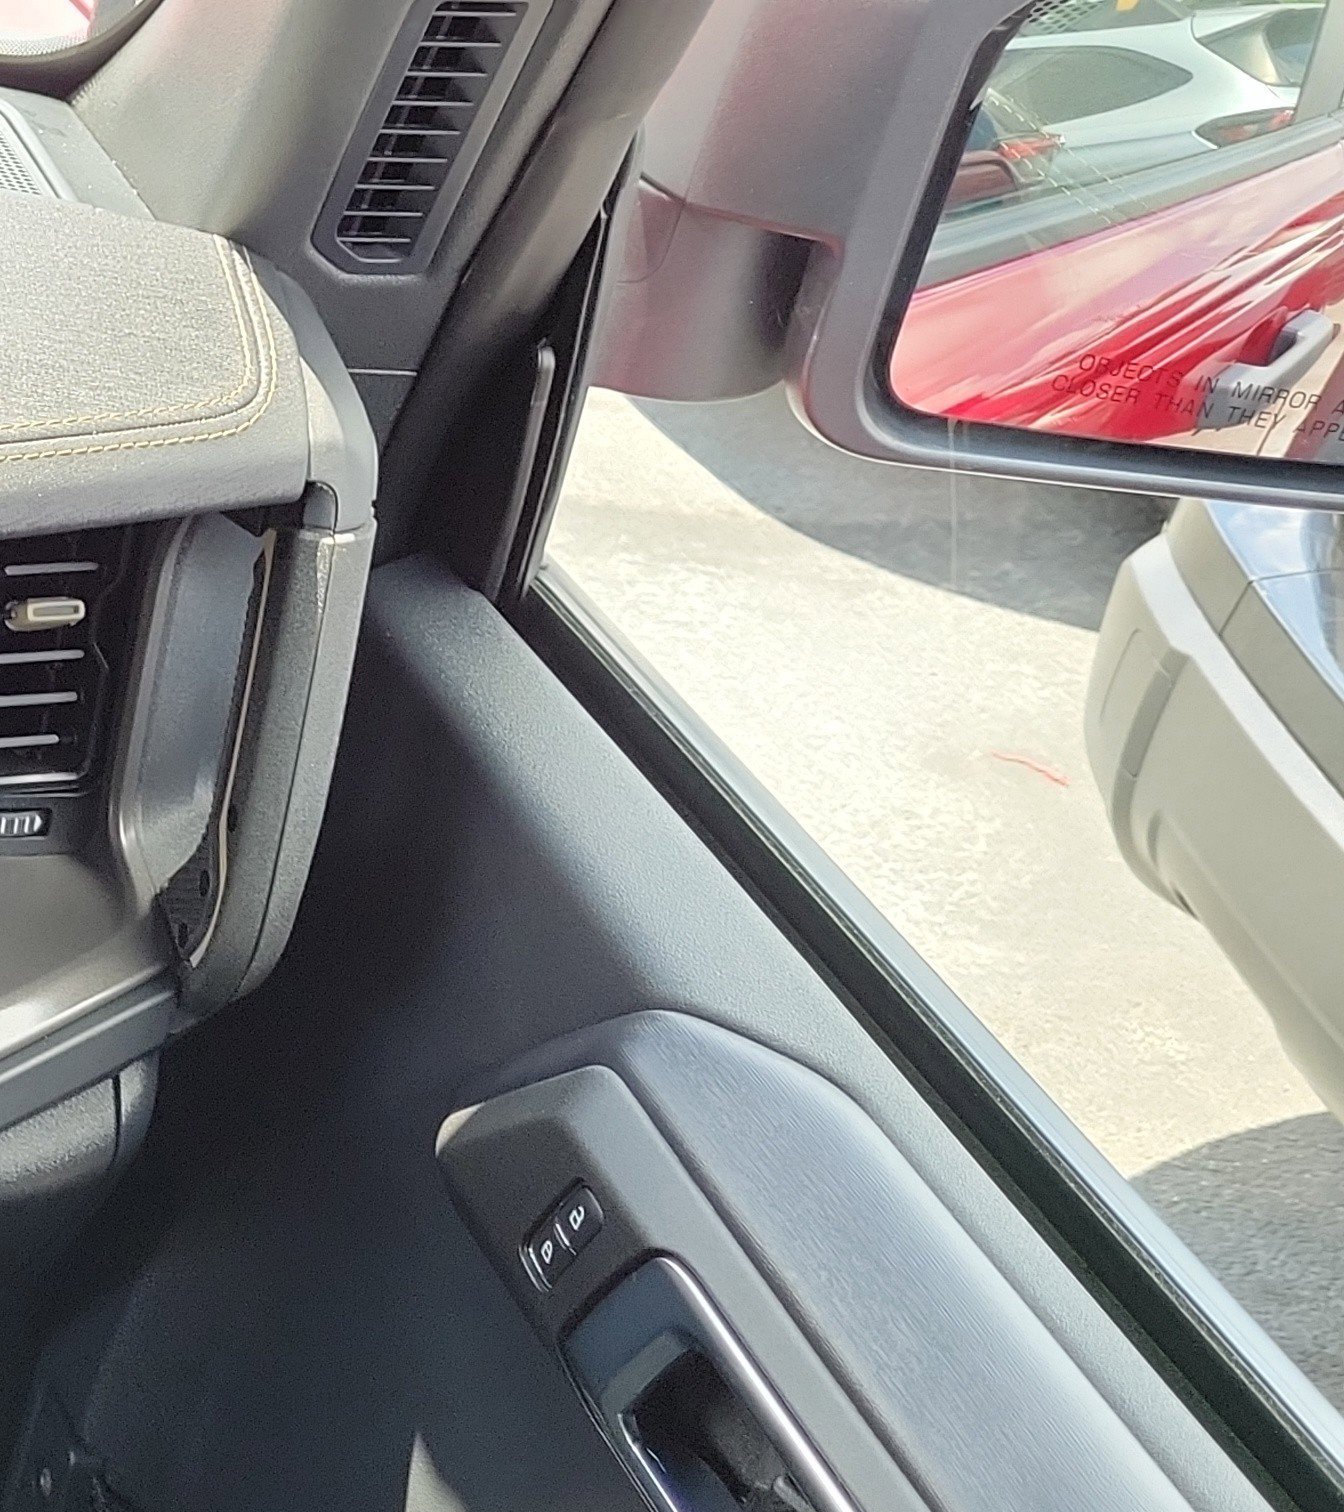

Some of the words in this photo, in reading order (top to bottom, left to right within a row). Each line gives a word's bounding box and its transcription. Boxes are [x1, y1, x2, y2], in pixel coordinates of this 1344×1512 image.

[1051, 375, 1141, 404] CLOSER
[1155, 393, 1214, 419] THAN
[1227, 406, 1286, 431] THEY
[1079, 353, 1185, 389] OBJECTS
[1194, 375, 1220, 395] IN
[1230, 382, 1322, 412] MIRROR
